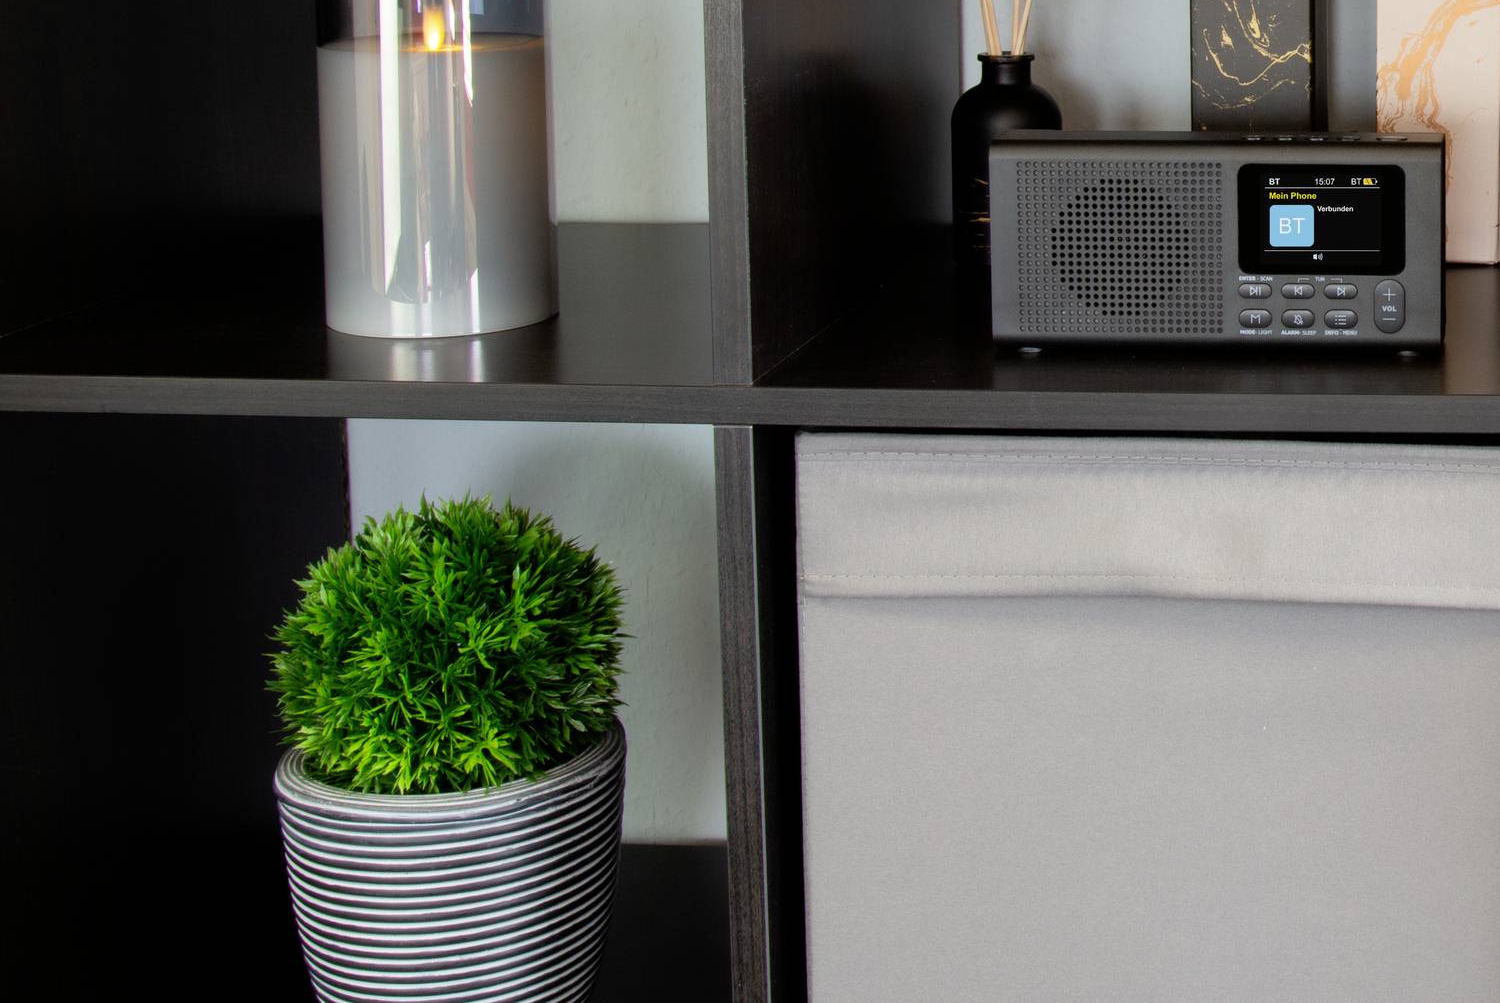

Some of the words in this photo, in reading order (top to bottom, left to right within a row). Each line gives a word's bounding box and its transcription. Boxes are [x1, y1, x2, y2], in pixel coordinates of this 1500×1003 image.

[1268, 177, 1281, 186] BT
[1314, 177, 1335, 186] 15:07
[1350, 177, 1362, 186] BT
[1268, 191, 1289, 200] Mein
[1290, 191, 1317, 200] Phone
[1317, 205, 1354, 213] Verbunden
[1279, 217, 1306, 235] BT
